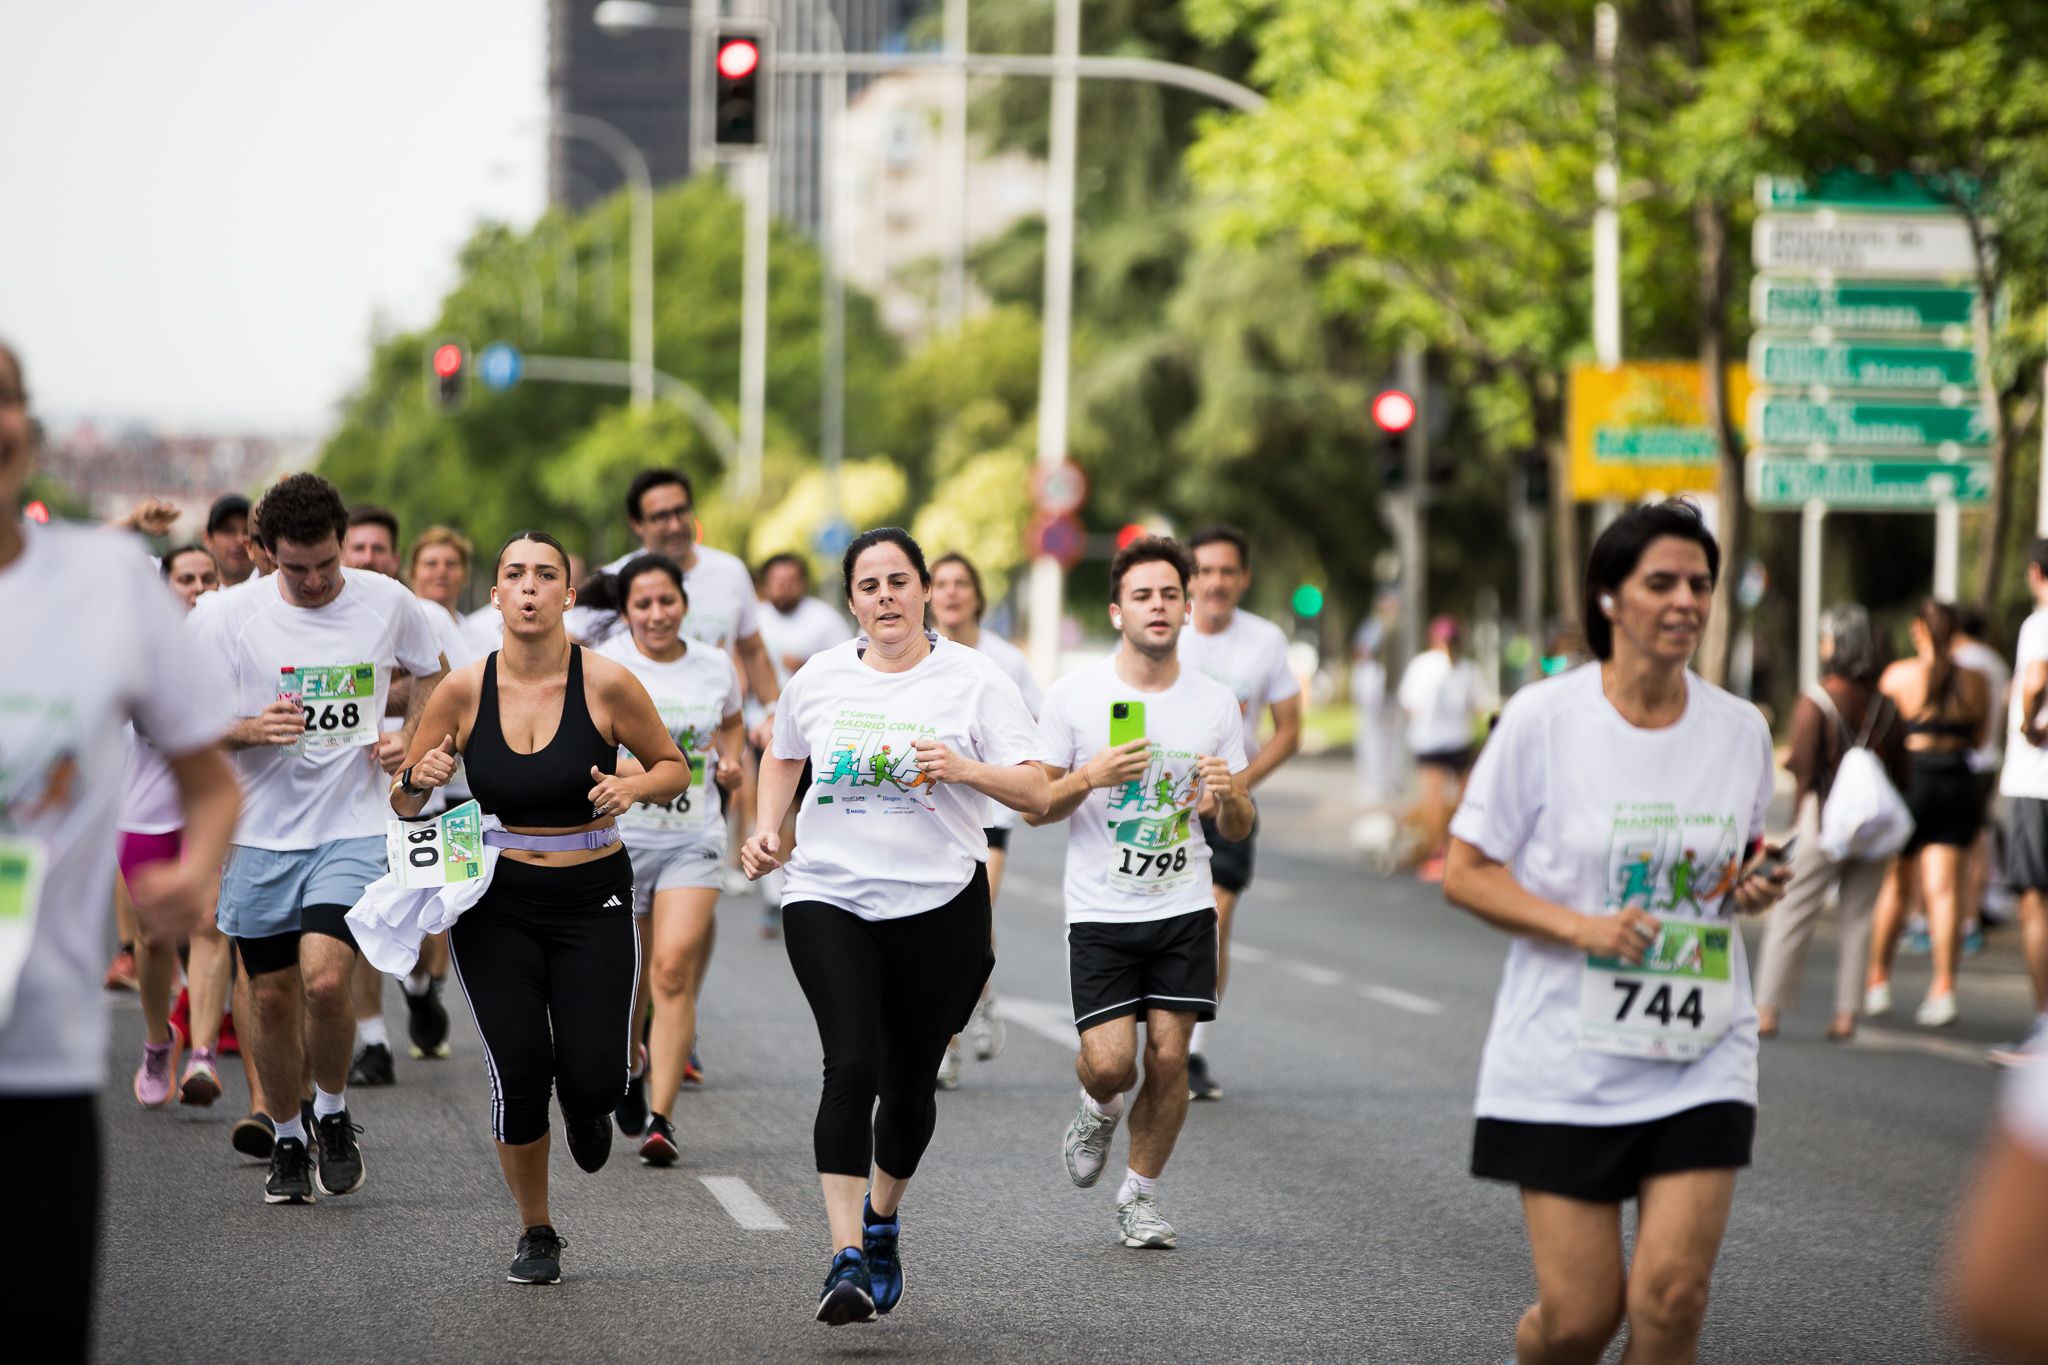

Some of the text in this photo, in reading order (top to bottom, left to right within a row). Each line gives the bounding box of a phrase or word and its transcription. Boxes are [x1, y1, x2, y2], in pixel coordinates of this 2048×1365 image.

[301, 673, 357, 697] ELA
[303, 703, 360, 731] 268
[834, 719, 936, 734] MADRID CON LA
[407, 823, 439, 868] 80
[1118, 847, 1188, 878] 1798
[1613, 978, 1705, 1029] 744
